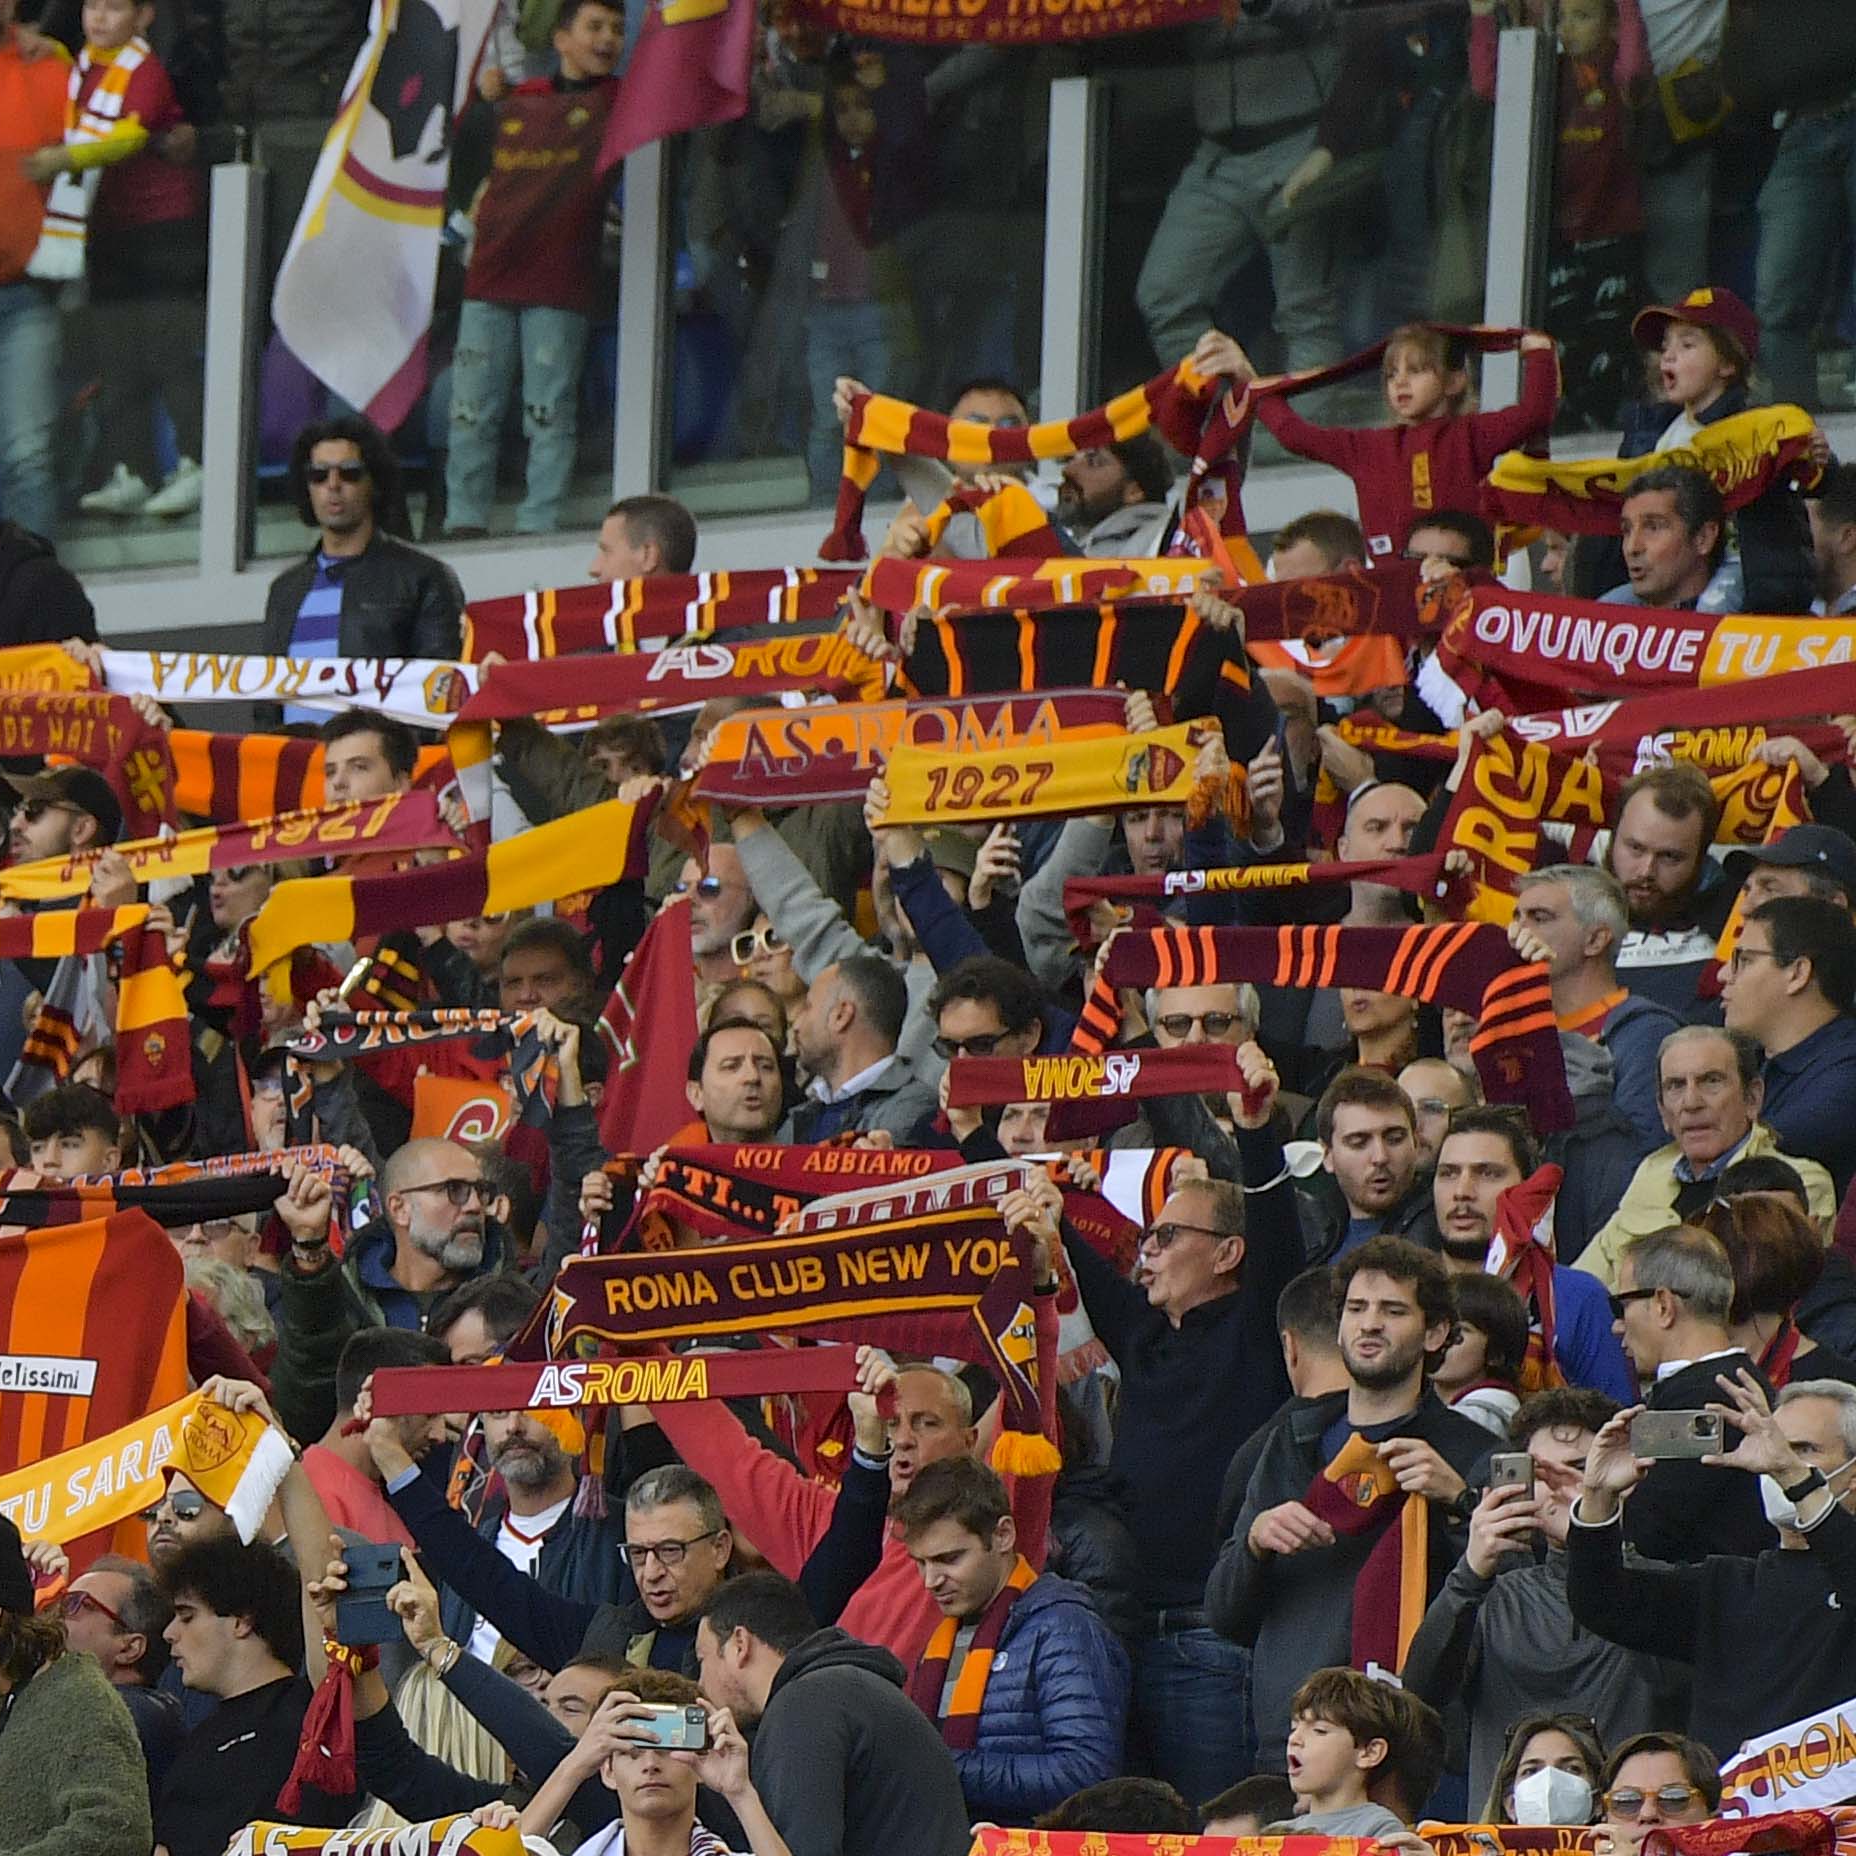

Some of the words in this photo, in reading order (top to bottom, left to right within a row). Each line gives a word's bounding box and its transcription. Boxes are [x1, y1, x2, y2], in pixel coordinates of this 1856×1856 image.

[1476, 604, 1703, 675] OVUNQUE
[1717, 632, 1776, 674] TU
[925, 763, 1054, 811] 1927
[1022, 1053, 1141, 1101] ASROMA
[733, 1148, 783, 1171] NOI
[802, 1147, 932, 1176] ABBIAMO
[604, 1265, 720, 1318] ROMA
[731, 1250, 827, 1302] CLUB
[838, 1242, 932, 1290] NEW
[528, 1357, 709, 1408] ASROMA
[0, 1495, 50, 1532] TU
